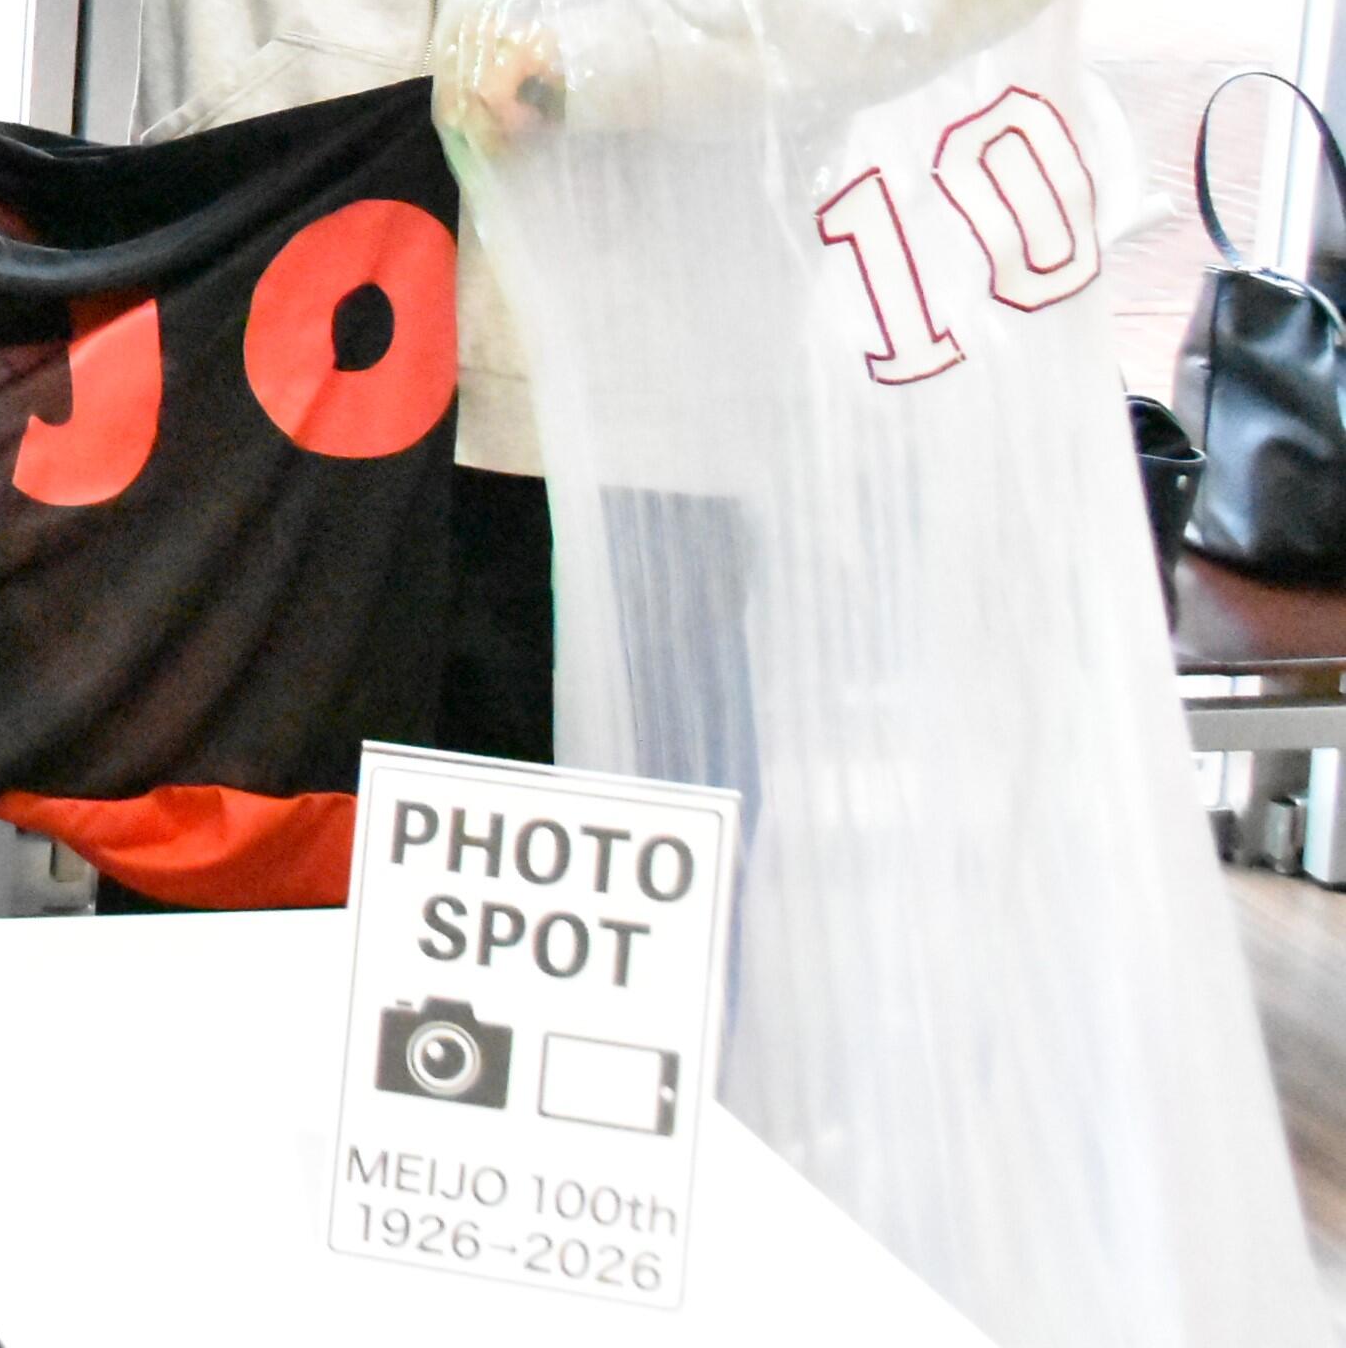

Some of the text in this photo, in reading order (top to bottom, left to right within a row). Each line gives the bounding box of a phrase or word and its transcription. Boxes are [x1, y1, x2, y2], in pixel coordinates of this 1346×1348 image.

[390, 798, 695, 903] PHOTO
[417, 894, 651, 988] SPOT
[346, 1144, 678, 1238] MEIJO 100th
